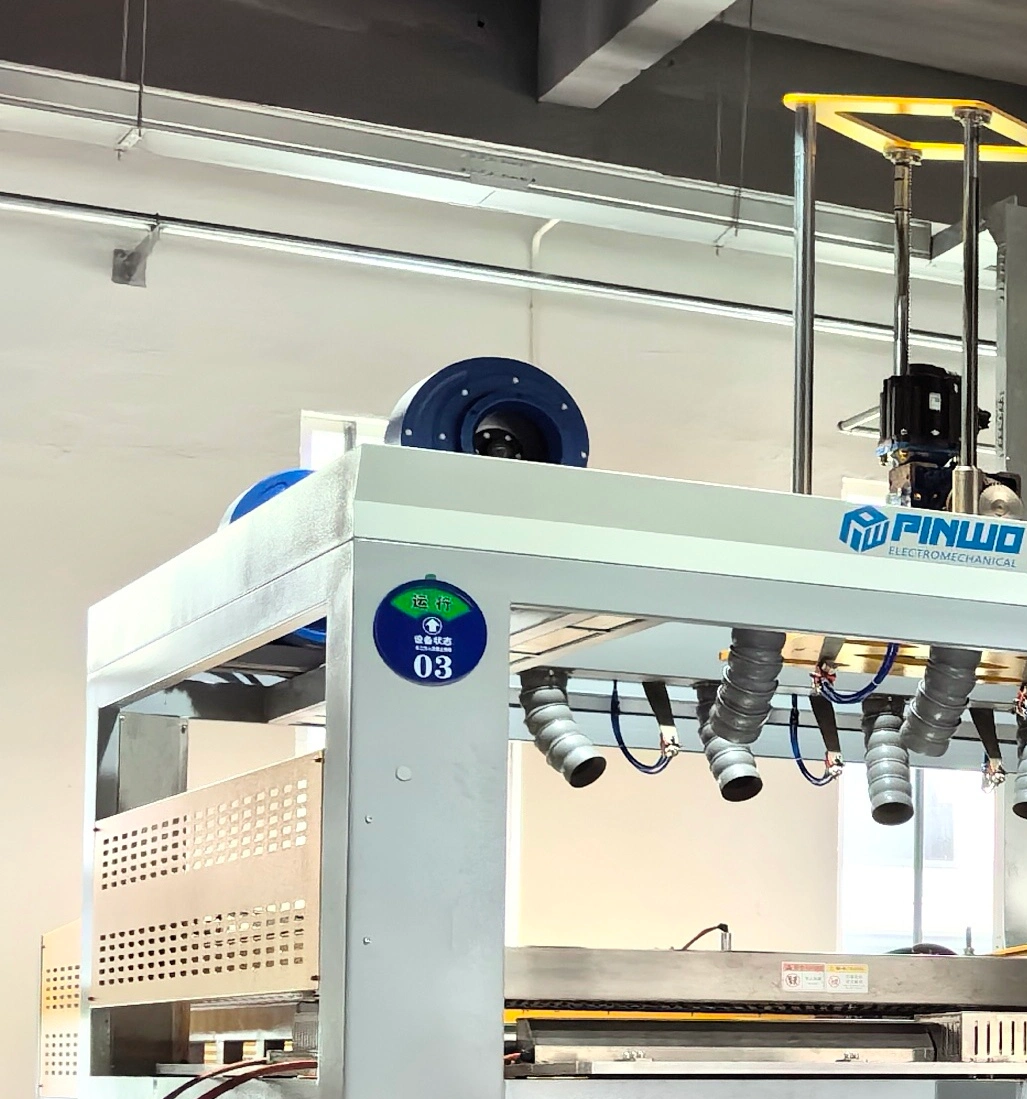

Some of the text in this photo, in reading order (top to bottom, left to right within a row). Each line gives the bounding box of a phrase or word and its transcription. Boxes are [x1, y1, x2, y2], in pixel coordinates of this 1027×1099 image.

[891, 513, 1025, 554] PINWO
[888, 546, 1016, 568] ELECTROMECHANICAL
[412, 593, 453, 612] 运行
[413, 653, 453, 679] 03
